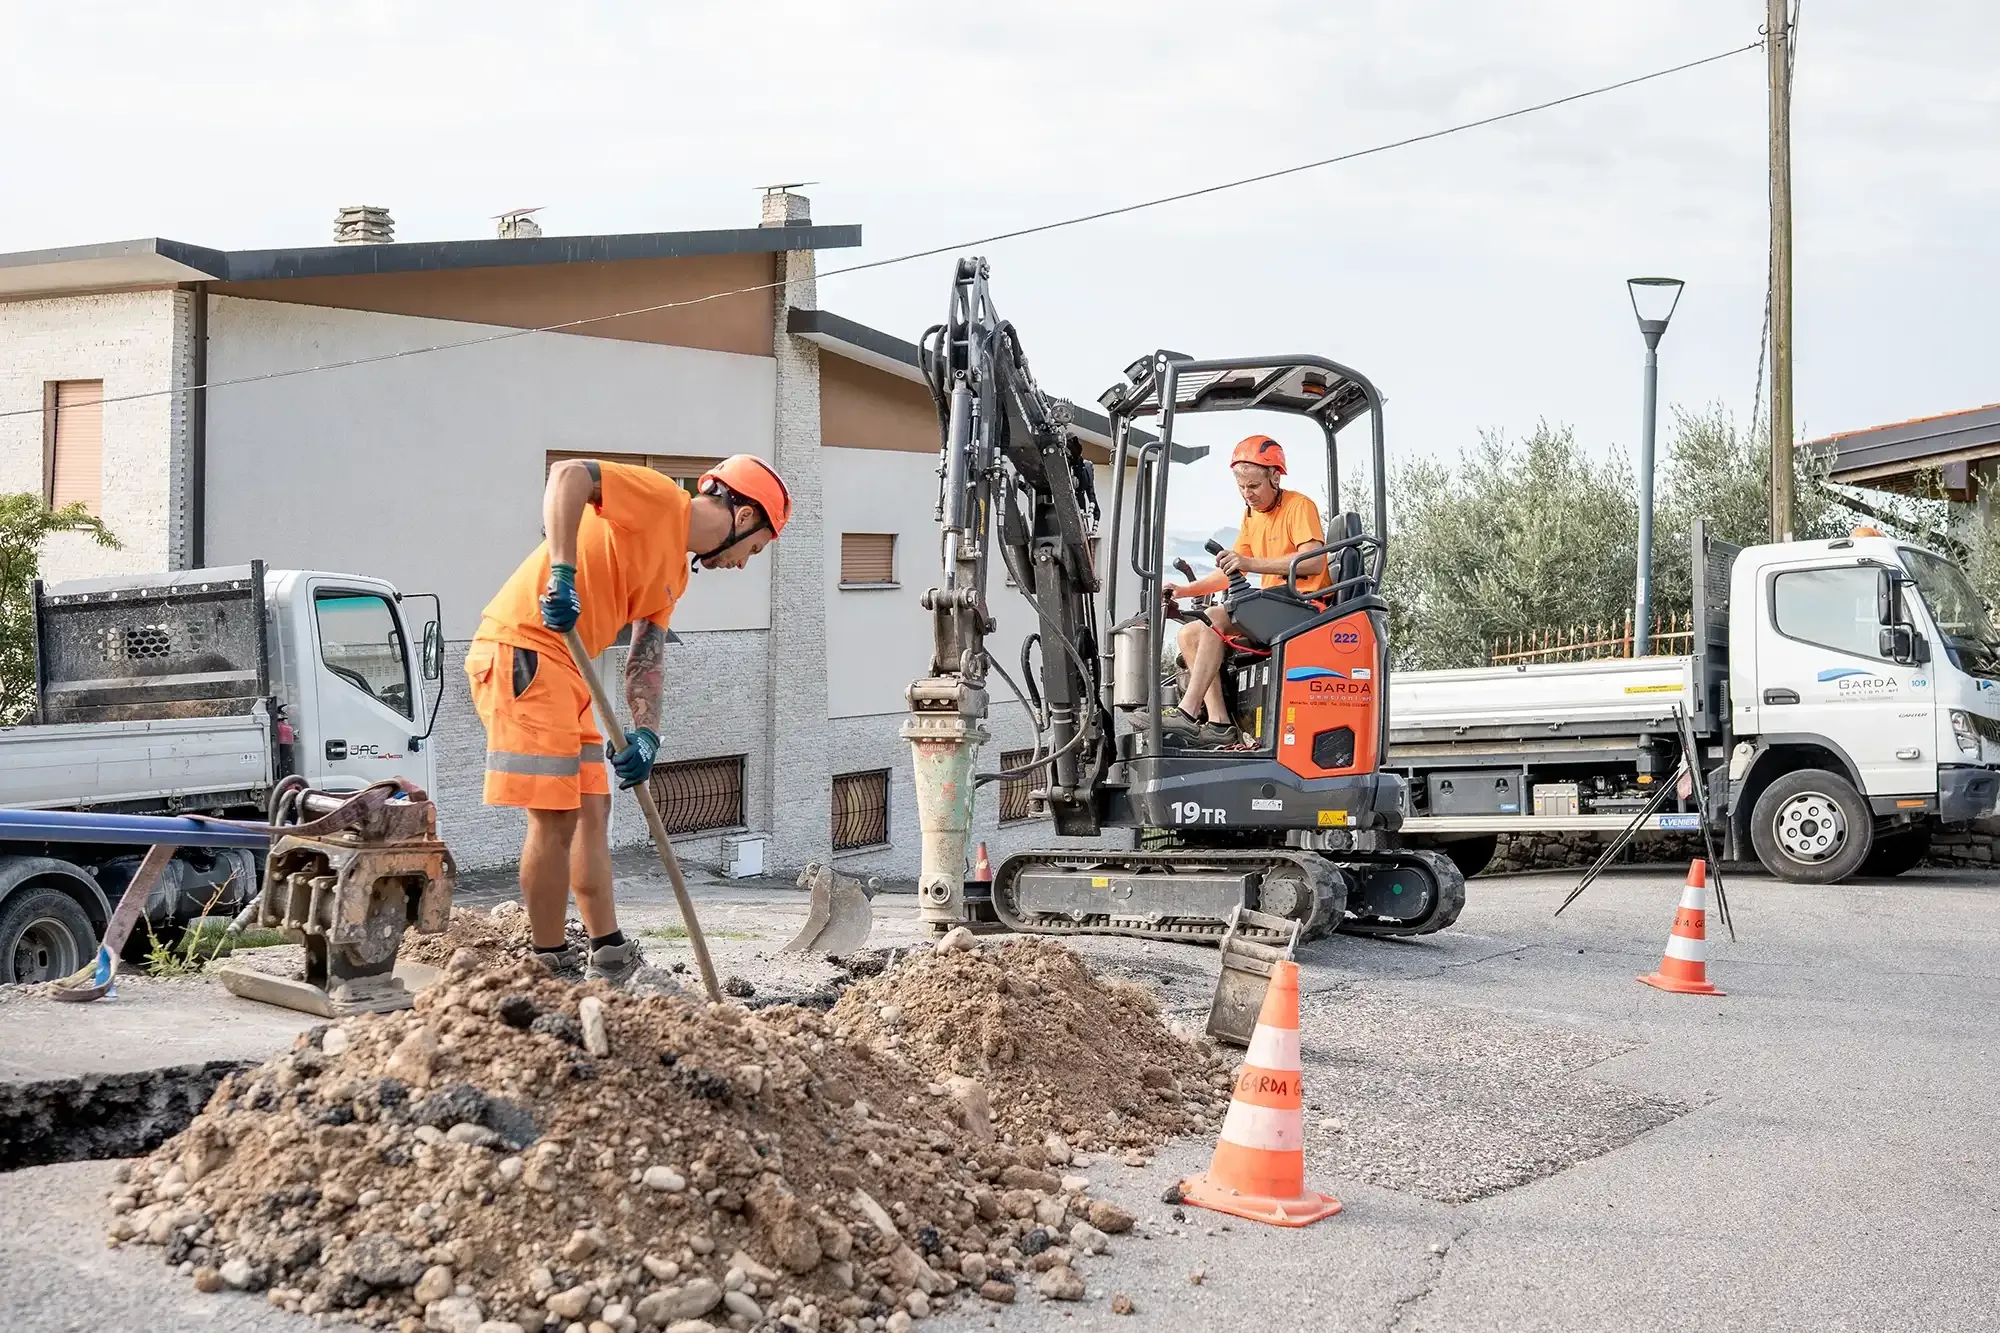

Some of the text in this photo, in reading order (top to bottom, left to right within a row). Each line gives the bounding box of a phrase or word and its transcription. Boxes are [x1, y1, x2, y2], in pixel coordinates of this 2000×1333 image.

[1334, 633, 1358, 643] 222
[1309, 680, 1371, 694] GARDA
[1839, 677, 1898, 690] GARDA
[350, 744, 379, 756] JAC
[1240, 1072, 1287, 1096] GARDA
